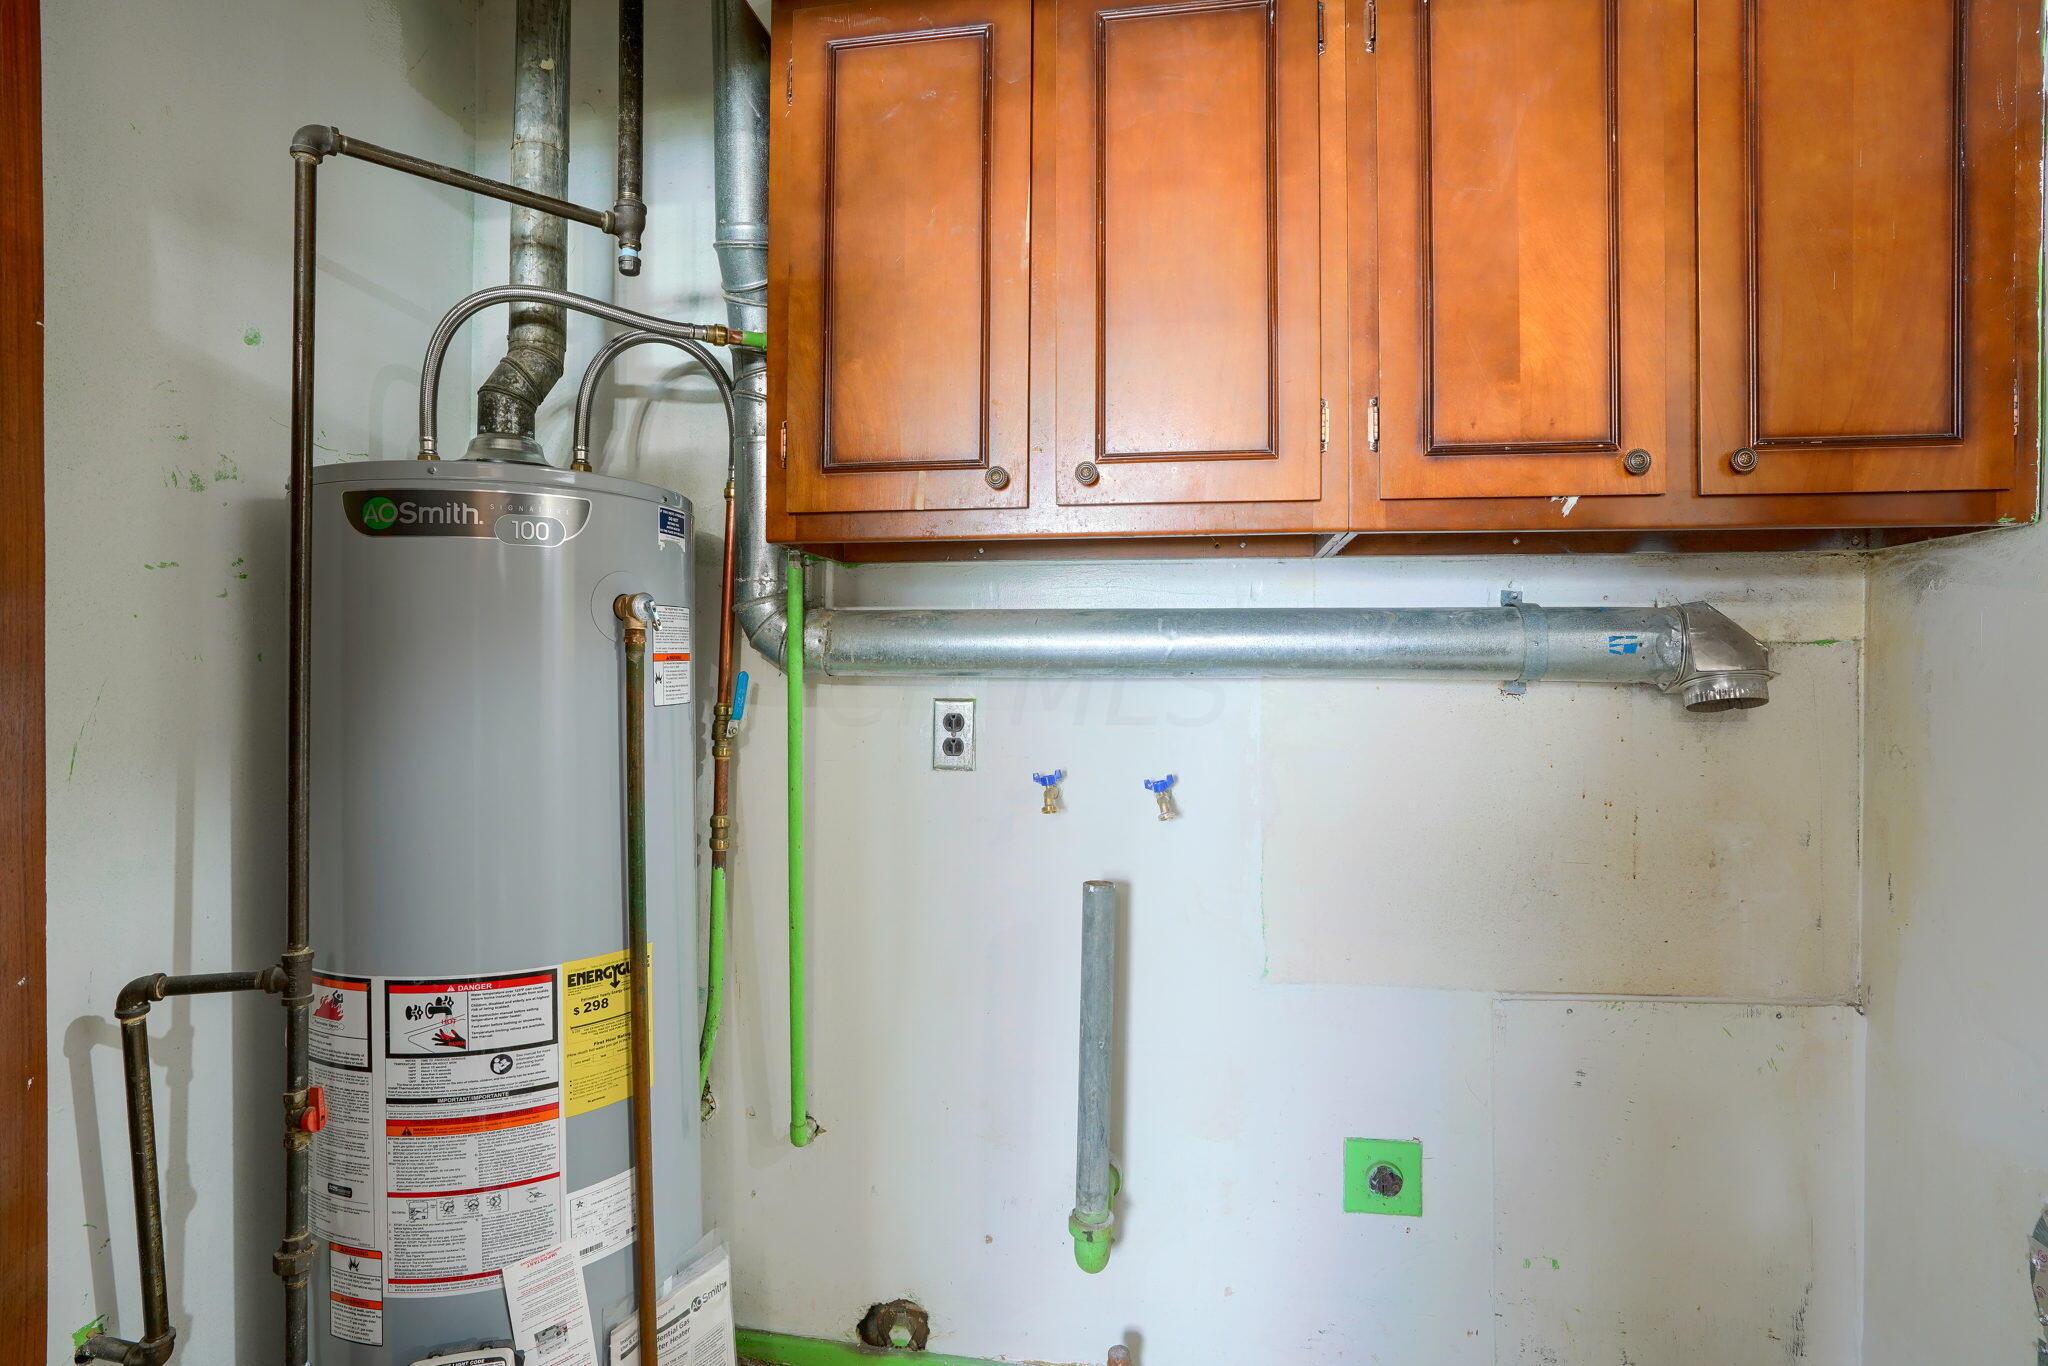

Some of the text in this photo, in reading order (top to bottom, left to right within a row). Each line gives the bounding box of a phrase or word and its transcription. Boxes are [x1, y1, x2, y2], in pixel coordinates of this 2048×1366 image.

[512, 520, 550, 541] 100
[458, 983, 492, 992] DANGER
[584, 998, 608, 1013] 298
[679, 1319, 690, 1328] Gas
[670, 1327, 691, 1344] Heater
